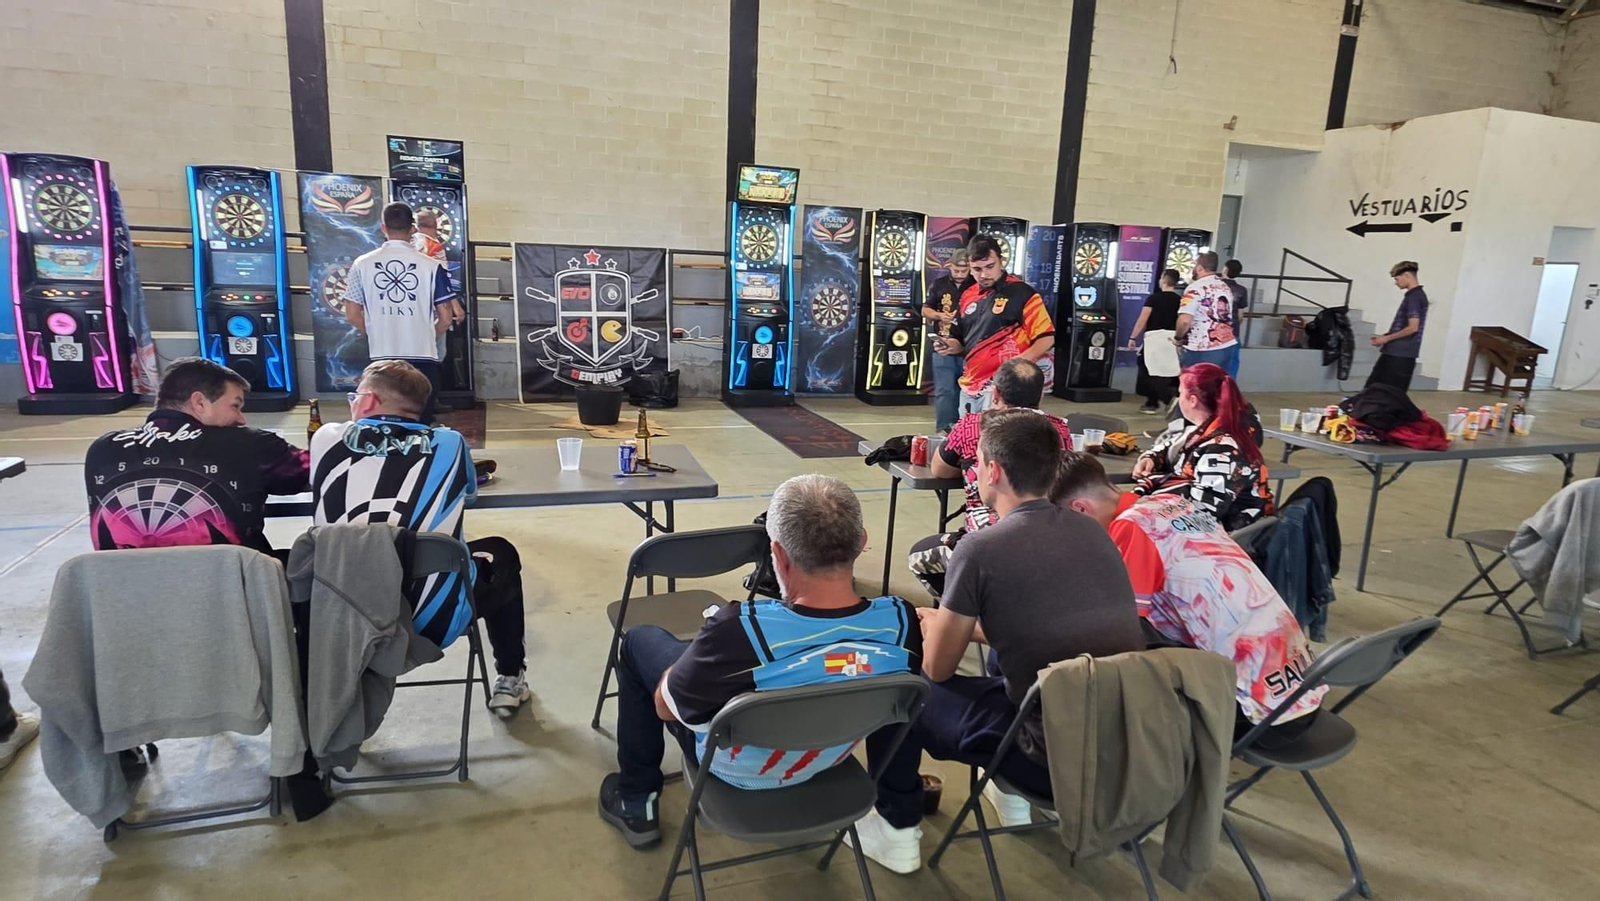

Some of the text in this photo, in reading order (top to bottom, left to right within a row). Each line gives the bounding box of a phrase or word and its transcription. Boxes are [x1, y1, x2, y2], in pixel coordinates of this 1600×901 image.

[321, 183, 362, 192] PHOENIX
[819, 216, 848, 224] PHOENIX
[1042, 230, 1056, 241] 20
[1041, 262, 1052, 274] 18
[1118, 260, 1154, 272] PHOENIX
[1040, 278, 1051, 290] 17
[1117, 282, 1151, 294] FESTIVAL
[143, 456, 160, 465] 20
[179, 457, 185, 466] 1
[118, 462, 127, 471] 5
[203, 465, 218, 474] 18
[94, 475, 104, 485] 12
[230, 480, 238, 489] 4
